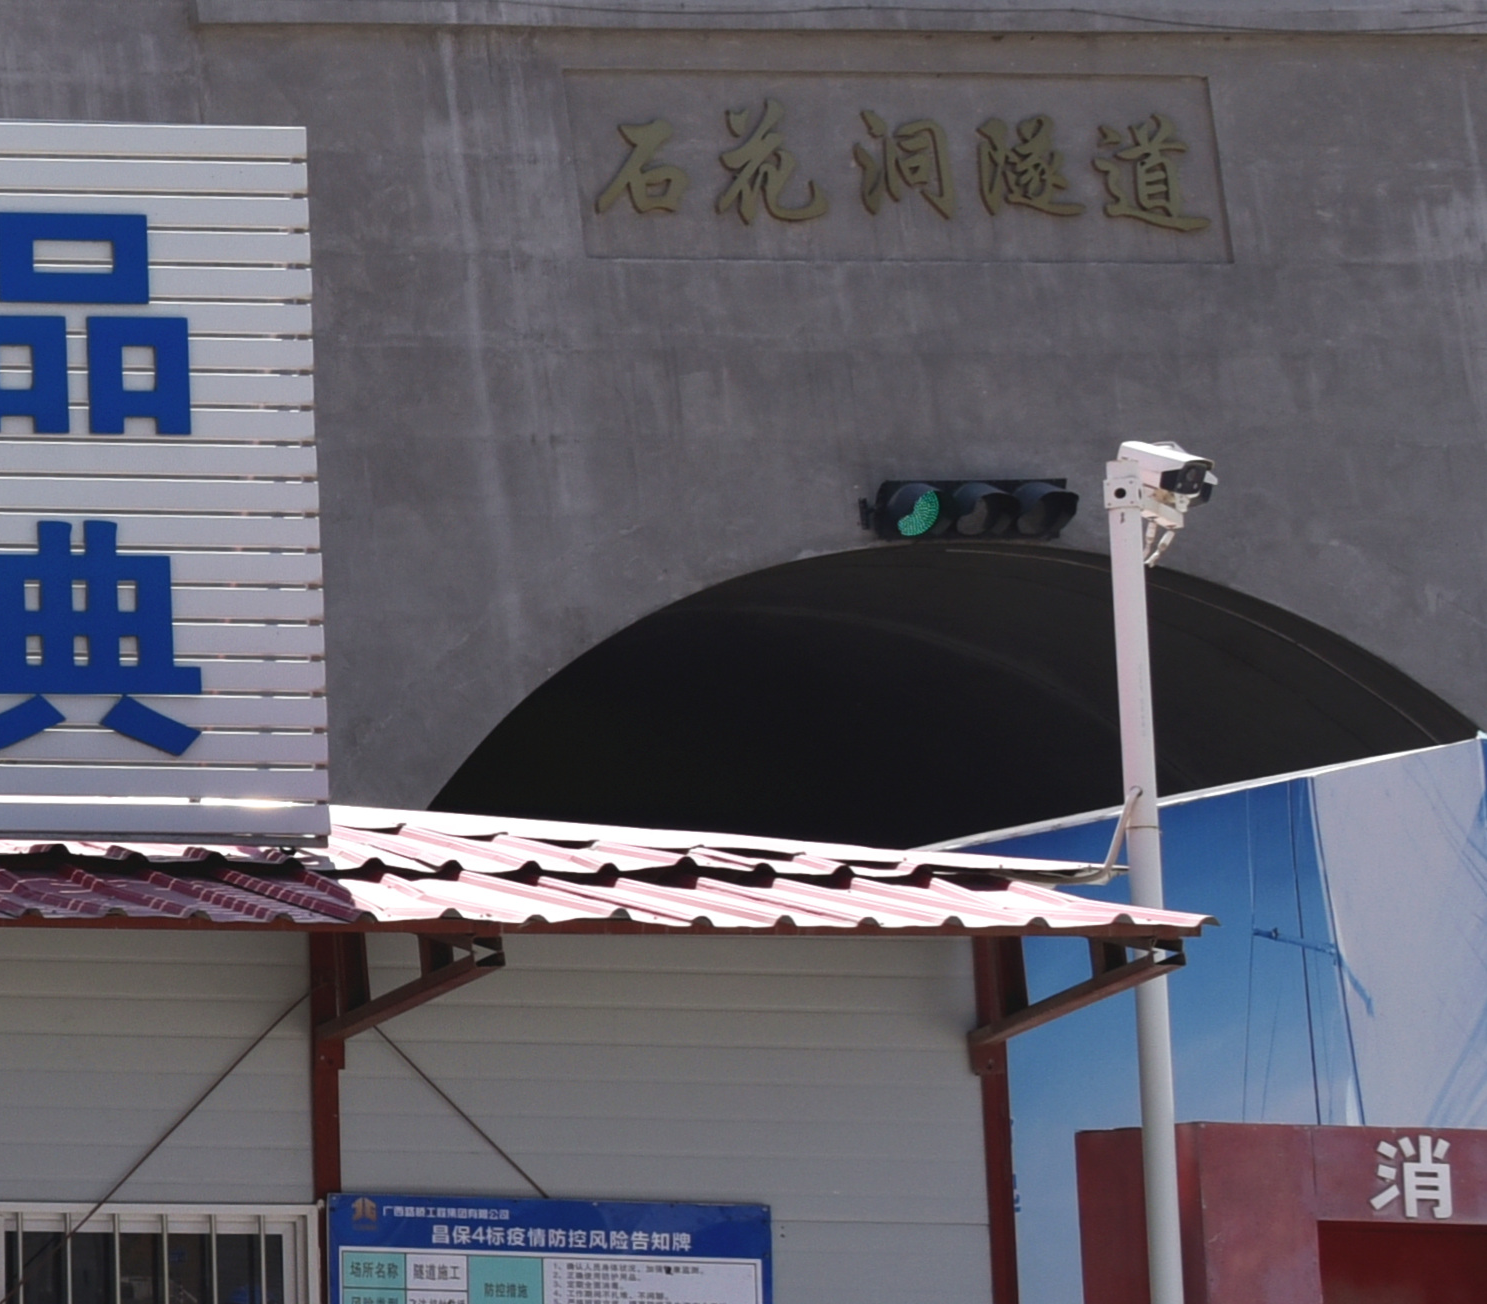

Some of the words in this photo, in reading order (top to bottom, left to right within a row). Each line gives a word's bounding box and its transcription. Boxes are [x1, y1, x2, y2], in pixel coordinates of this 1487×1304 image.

[595, 99, 1211, 233] 石花洞隧道
[1370, 1134, 1453, 1220] 消
[431, 1224, 692, 1252] 昌保4标疫情防控风险告知牌
[350, 1261, 399, 1279] 场所名称
[413, 1263, 461, 1281] 隧道施工
[484, 1282, 528, 1298] 防控措施
